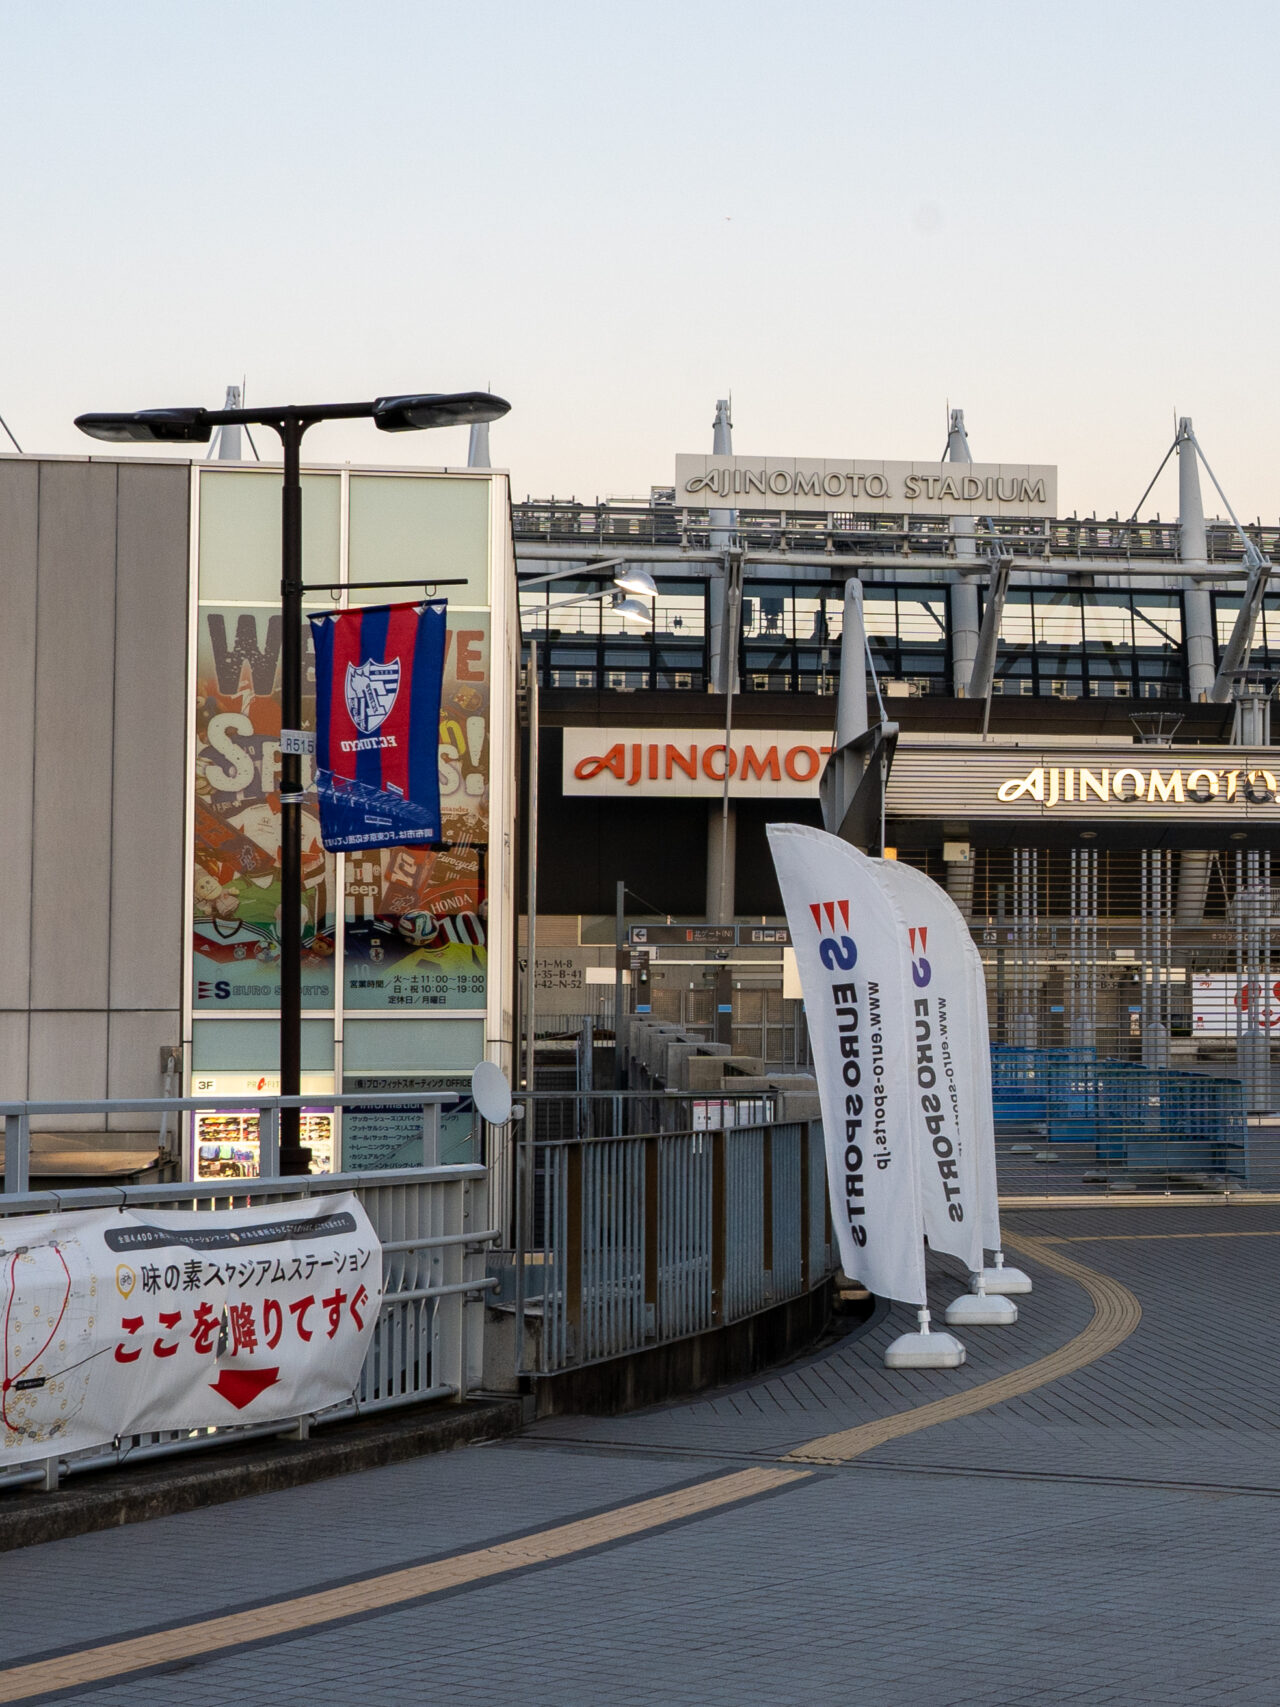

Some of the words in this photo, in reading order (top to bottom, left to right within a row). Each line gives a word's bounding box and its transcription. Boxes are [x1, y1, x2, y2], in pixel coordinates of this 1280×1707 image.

[904, 474, 1046, 502] STADIUM
[286, 737, 315, 753] R515
[573, 743, 837, 785] AJINOMO
[430, 894, 473, 914] HONDA
[233, 985, 271, 996] EURO
[274, 985, 329, 996] SORTS
[198, 1081, 213, 1090] 3F
[446, 1079, 471, 1087] OFFICE
